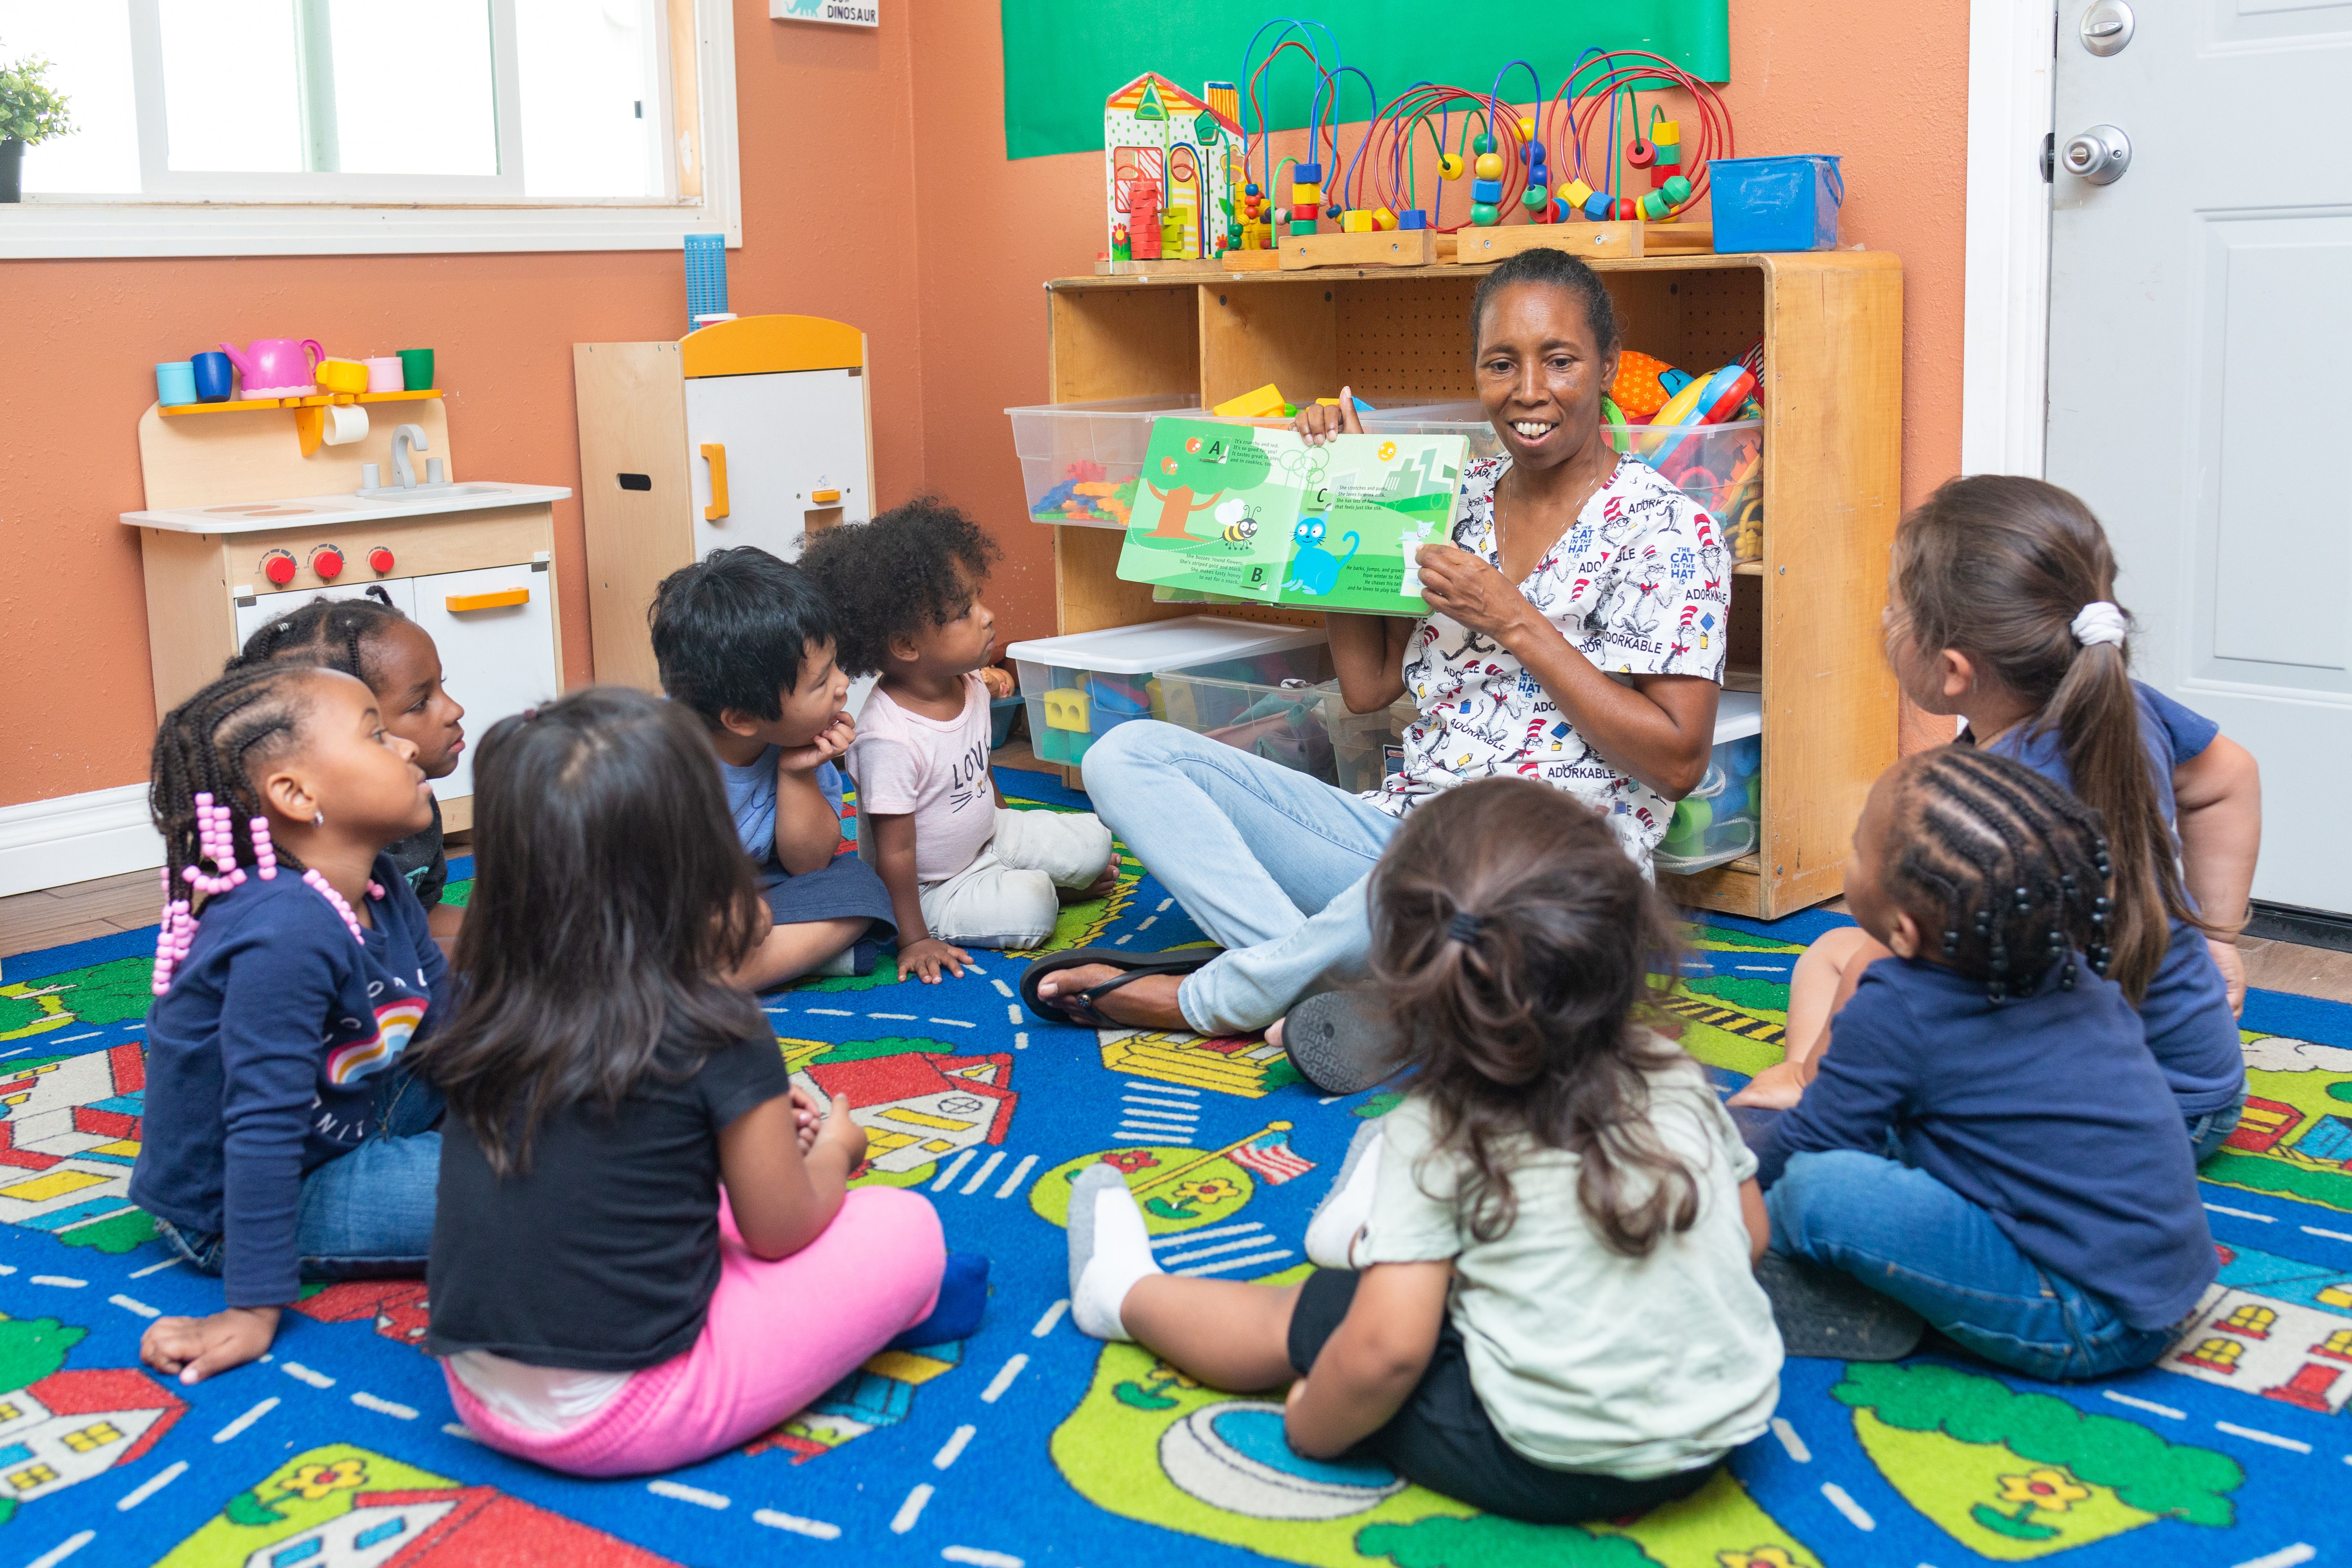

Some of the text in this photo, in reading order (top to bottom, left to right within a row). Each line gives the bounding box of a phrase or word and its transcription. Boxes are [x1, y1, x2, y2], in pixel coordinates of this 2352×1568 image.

[828, 5, 875, 22] DINOSAUR
[1209, 441, 1219, 454] A
[1317, 488, 1327, 502] C
[1572, 530, 1595, 539] CAT
[1568, 545, 1590, 553] HAT
[1670, 553, 1695, 563] CAT
[1251, 567, 1263, 582] B
[1671, 569, 1695, 579] HAT
[1605, 631, 1662, 654] DORKABLE
[1518, 682, 1541, 693] HAT
[1547, 767, 1616, 779] ADORKABLE
